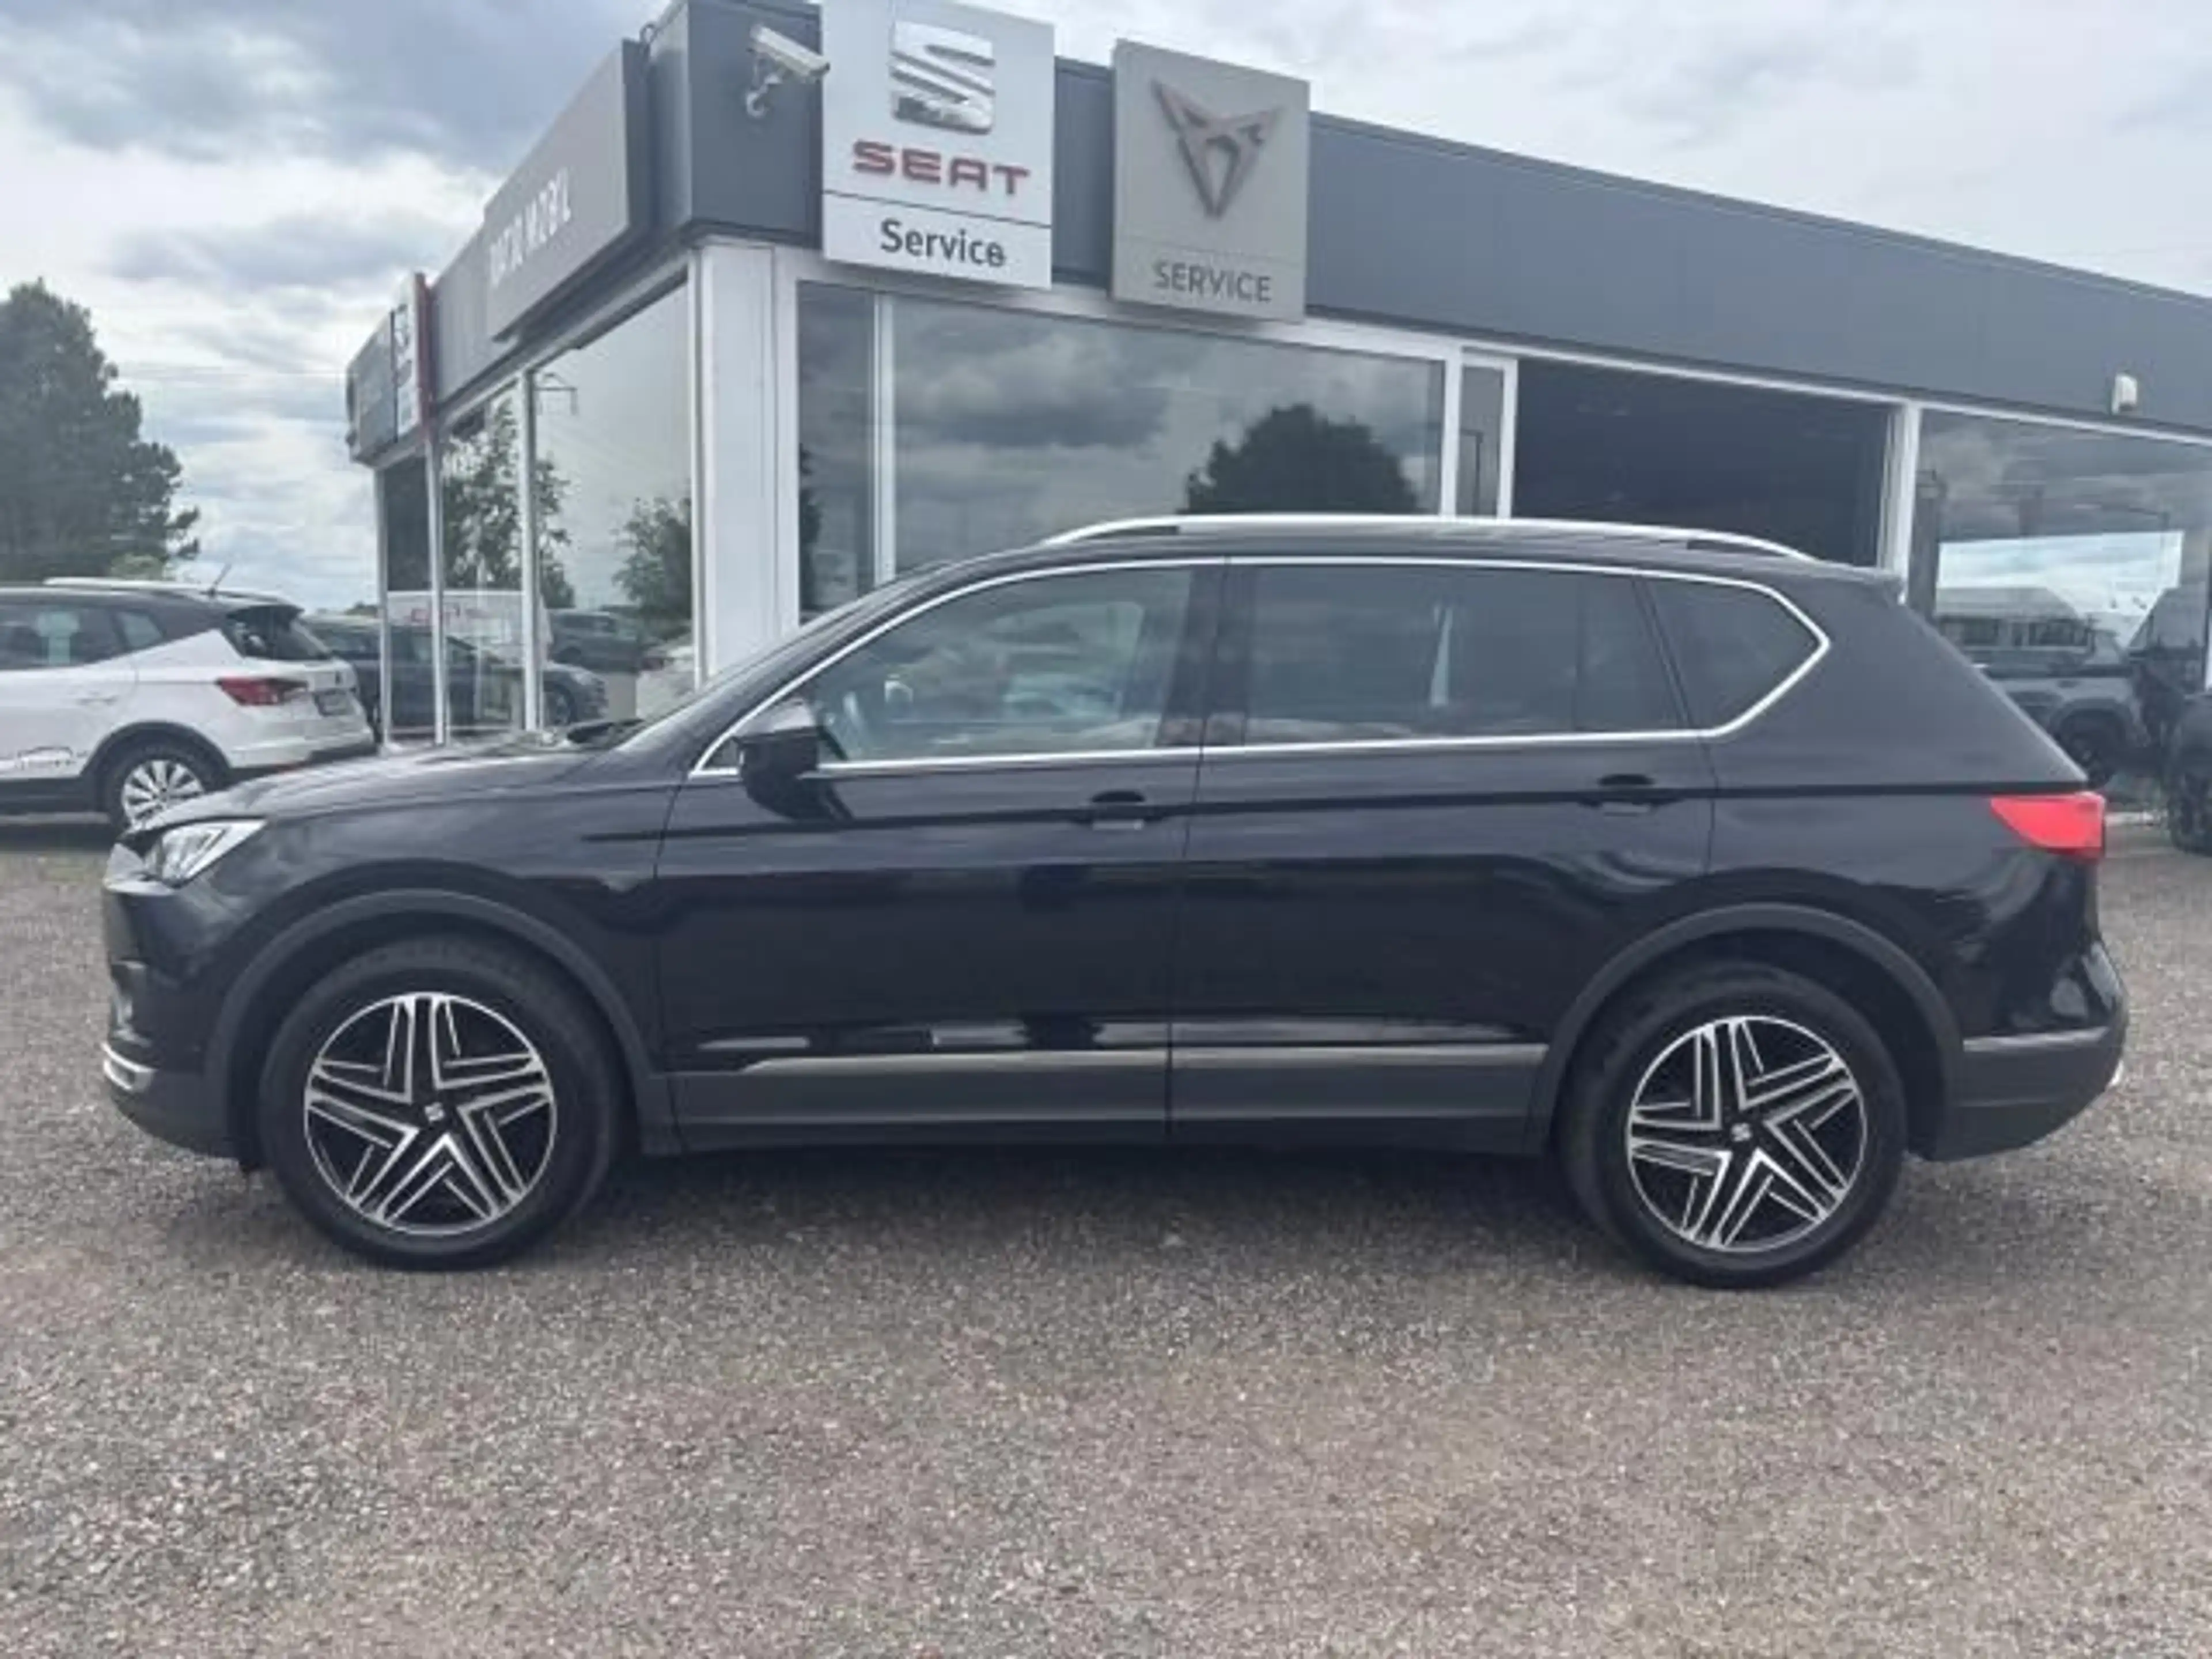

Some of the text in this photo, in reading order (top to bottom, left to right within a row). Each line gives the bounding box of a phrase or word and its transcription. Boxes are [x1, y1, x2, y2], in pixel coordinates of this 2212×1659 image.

[853, 141, 1031, 195] SEAT
[880, 217, 1005, 267] Service
[1154, 260, 1272, 303] SERVICE
